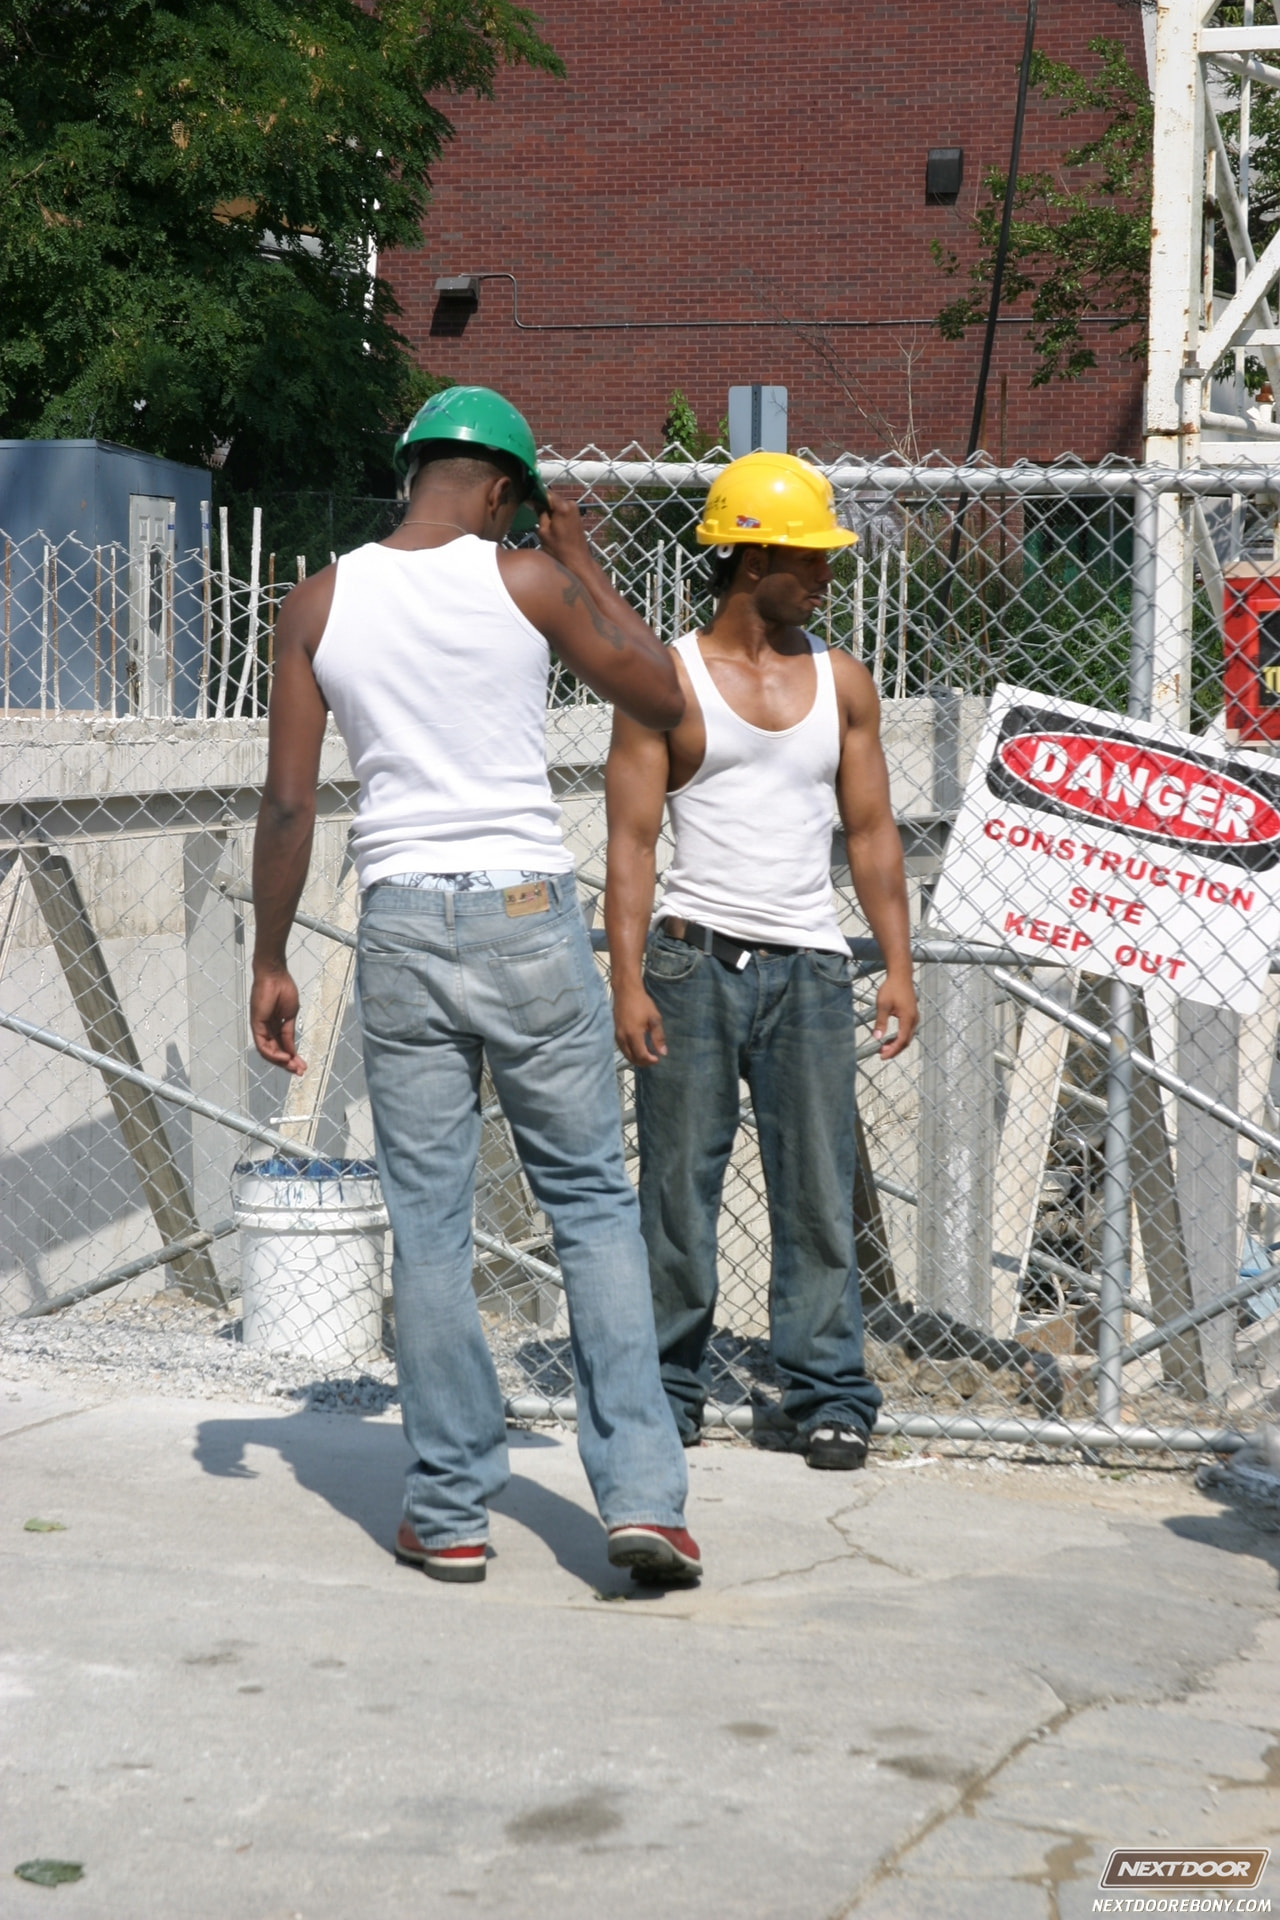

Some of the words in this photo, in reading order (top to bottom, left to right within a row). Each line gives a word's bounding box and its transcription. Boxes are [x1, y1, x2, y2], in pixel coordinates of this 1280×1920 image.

[1030, 740, 1256, 839] DANGER
[984, 819, 1254, 911] CONSTRUCTION
[1069, 887, 1145, 924] SITE
[1004, 912, 1091, 952] KEEP
[1115, 945, 1186, 979] OUT
